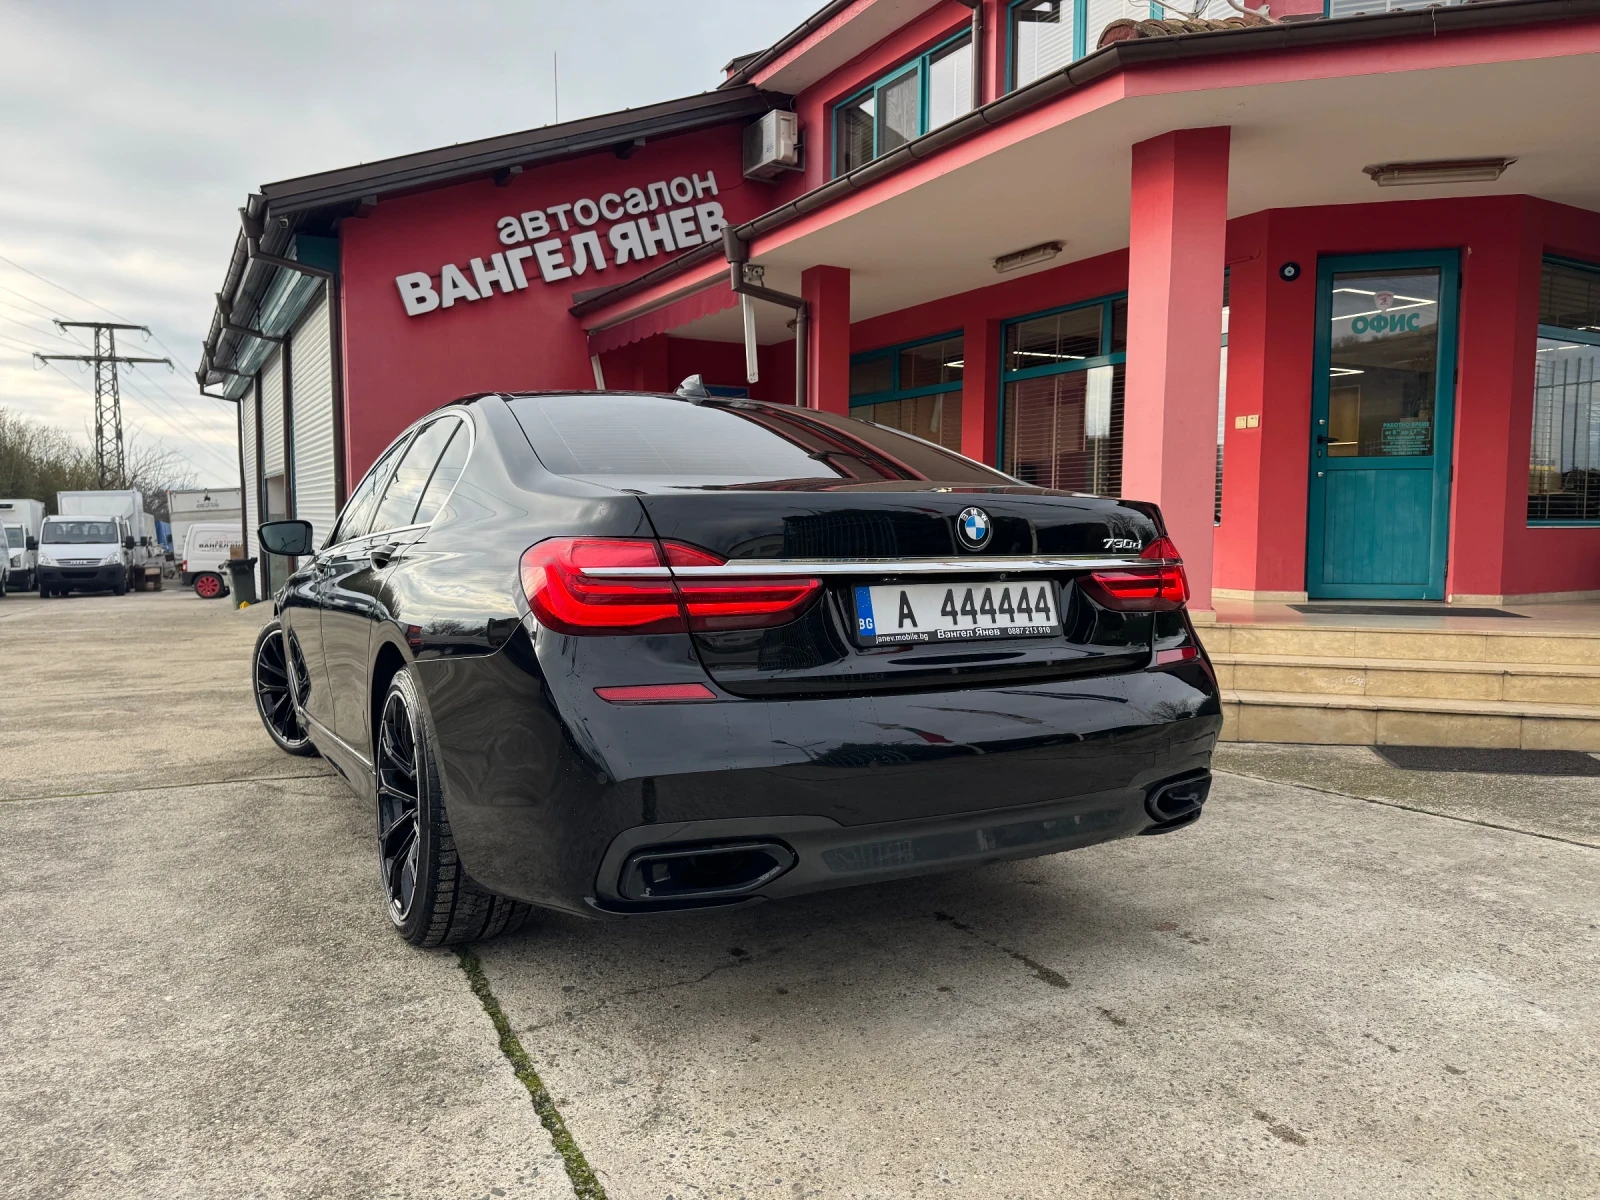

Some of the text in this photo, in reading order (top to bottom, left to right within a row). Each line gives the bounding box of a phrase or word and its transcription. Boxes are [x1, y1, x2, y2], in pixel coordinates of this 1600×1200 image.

[496, 170, 719, 245] автосалон
[395, 201, 728, 317] ВАНГЕЛ ЯНЕВ
[1351, 312, 1420, 335] ОФИС
[1102, 538, 1142, 550] 730d
[940, 586, 1051, 626] 444444
[858, 618, 873, 630] BG
[937, 627, 1000, 639] Вангел Янев
[1007, 626, 1051, 635] 0887 213 910
[876, 633, 929, 644] janev.mobile.bg
